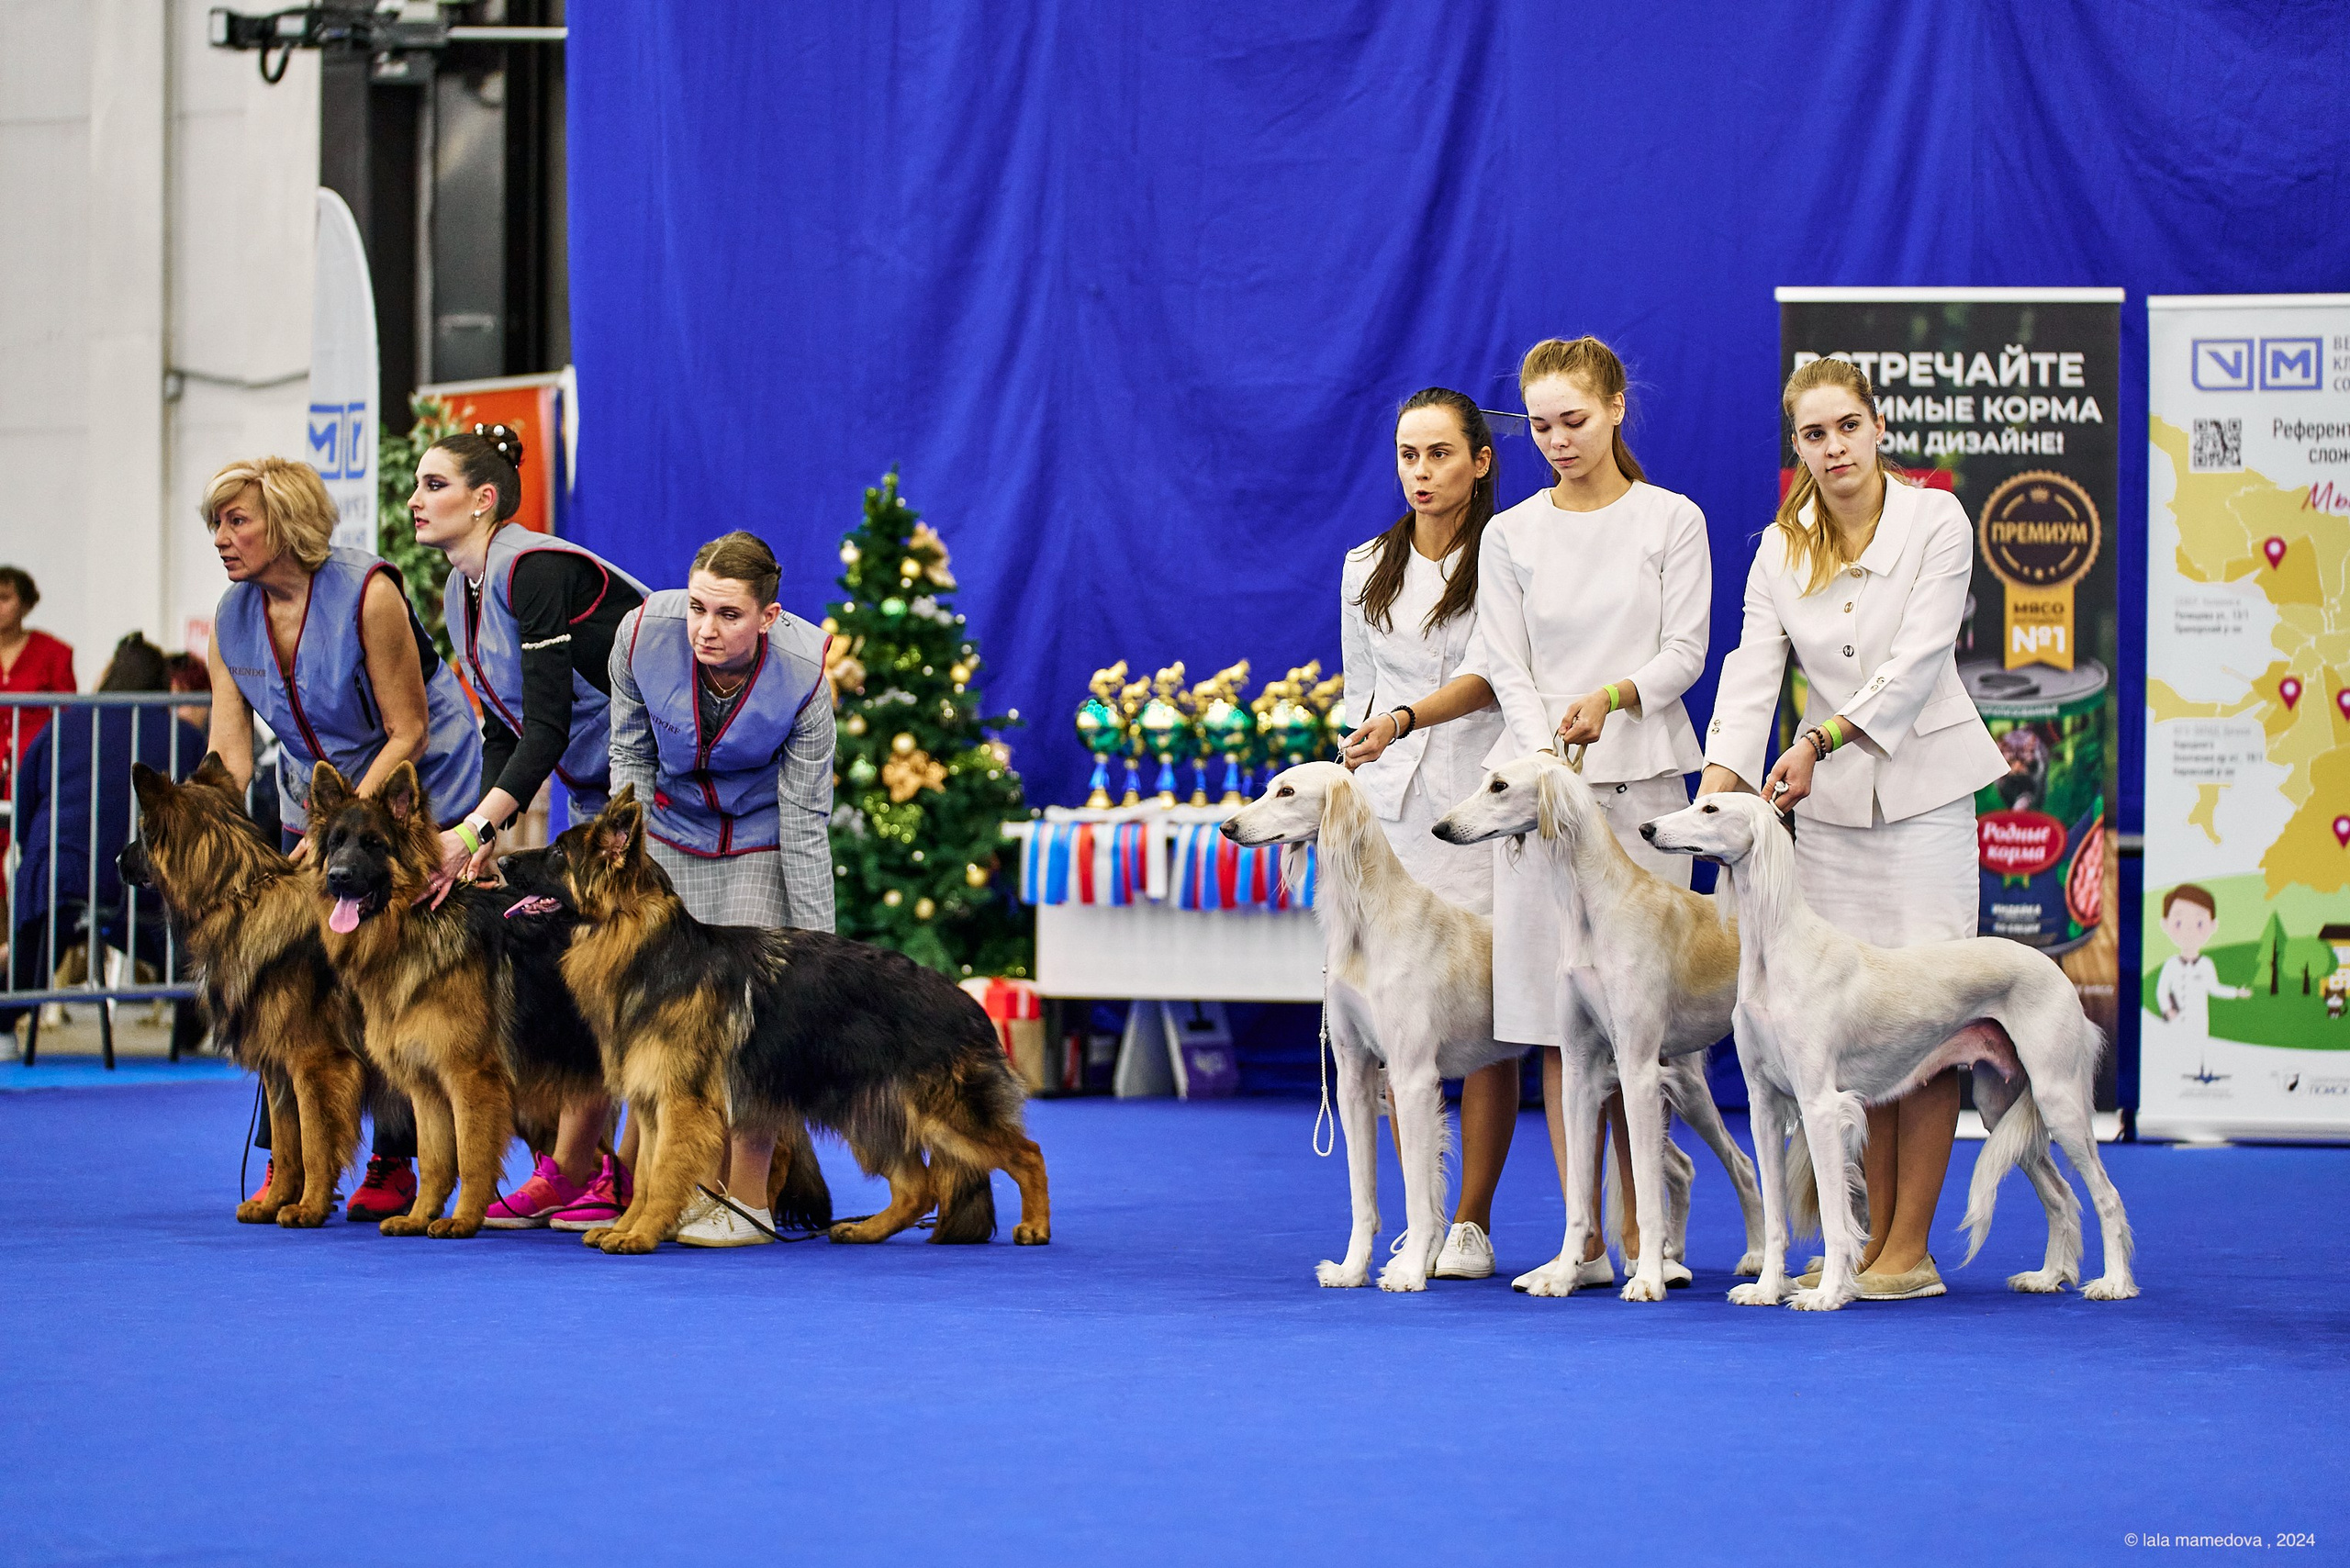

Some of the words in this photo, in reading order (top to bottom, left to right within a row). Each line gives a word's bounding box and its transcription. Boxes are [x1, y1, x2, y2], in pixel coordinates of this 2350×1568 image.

[1983, 395, 2104, 423] КОРМА
[1924, 427, 2065, 458] ДИЗАЙНЕ!
[1991, 521, 2088, 544] ПРЕМИУМ
[1983, 822, 2052, 843] Родные
[1986, 845, 2046, 867] корма
